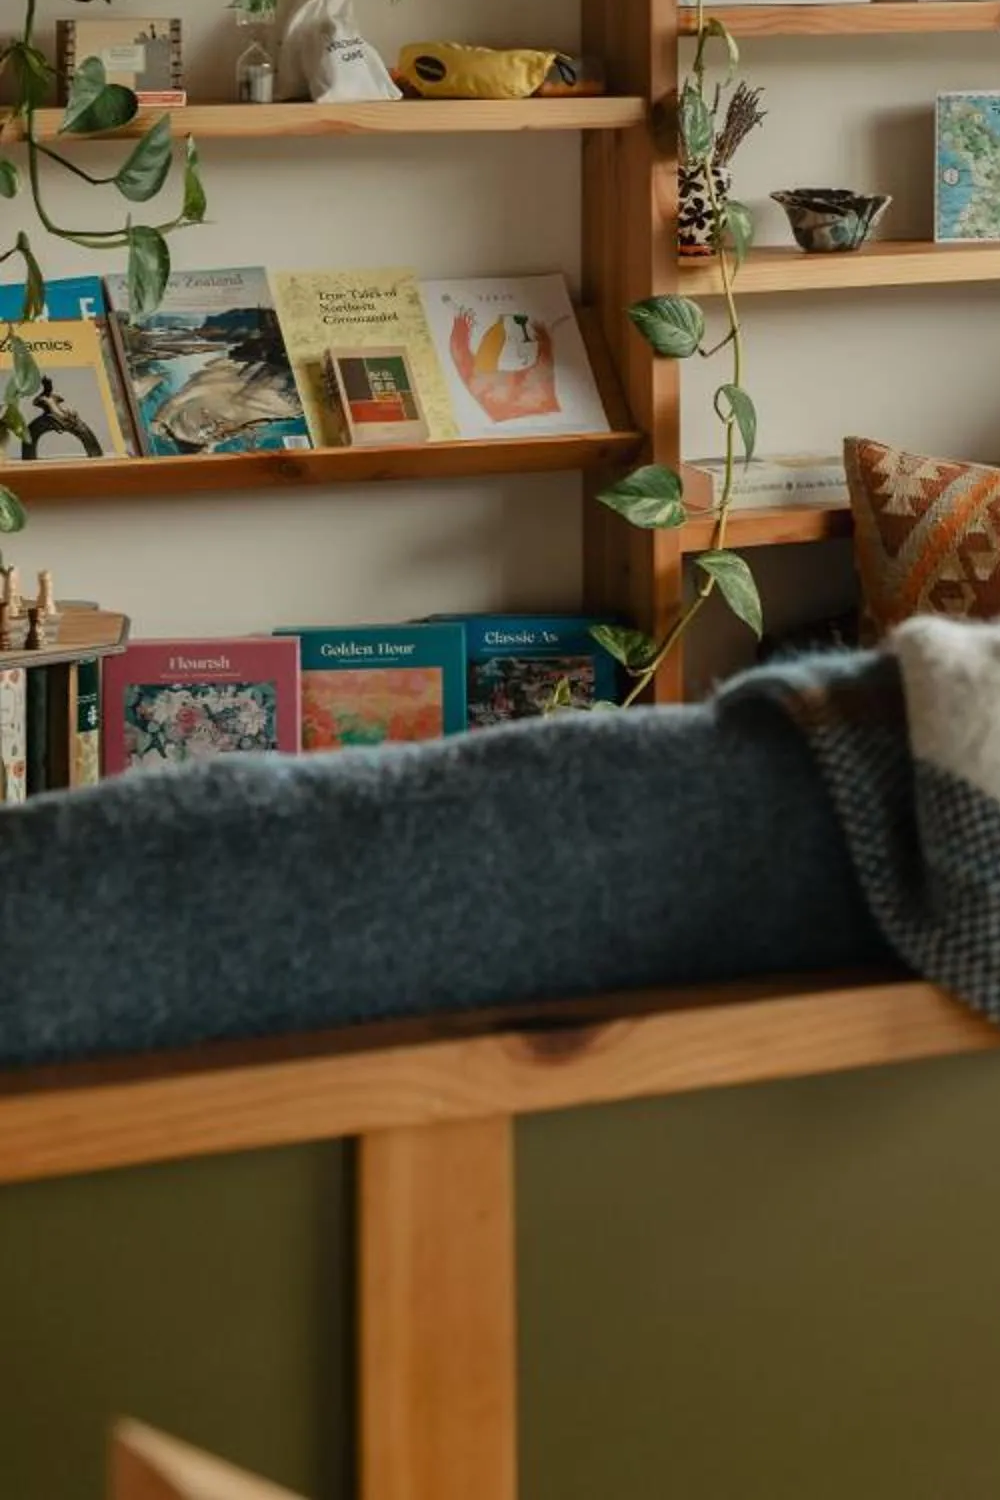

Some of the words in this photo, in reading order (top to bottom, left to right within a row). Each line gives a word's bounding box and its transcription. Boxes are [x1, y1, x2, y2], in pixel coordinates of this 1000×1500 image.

[322, 311, 399, 325] Coromandel
[0, 339, 73, 352] eamics
[484, 630, 536, 645] Classic
[320, 640, 374, 657] Golden
[377, 642, 416, 656] Hour
[169, 655, 231, 670] Flourish
